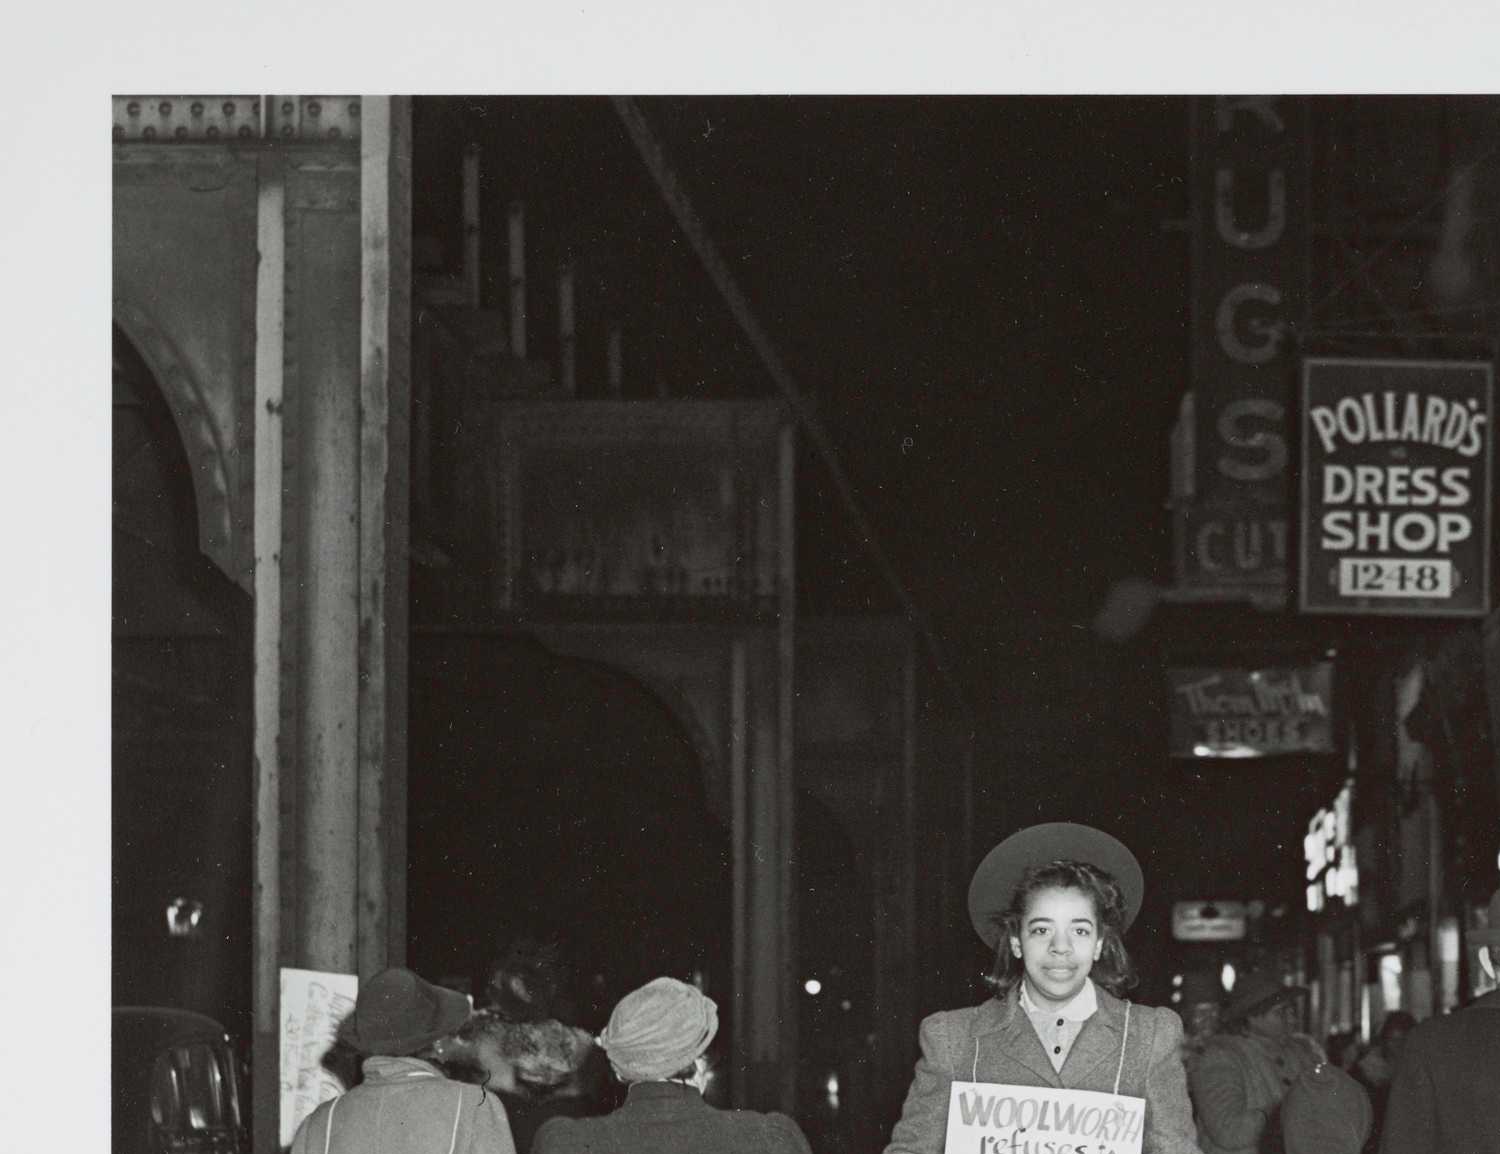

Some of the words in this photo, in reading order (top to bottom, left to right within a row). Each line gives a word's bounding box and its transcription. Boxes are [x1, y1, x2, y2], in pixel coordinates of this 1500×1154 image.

[1311, 391, 1487, 457] POLLARD'S
[1322, 464, 1471, 507] DRESS
[1320, 510, 1473, 553] SHOP
[1350, 563, 1440, 592] 1248
[957, 1090, 1145, 1144] WOOLWORTH
